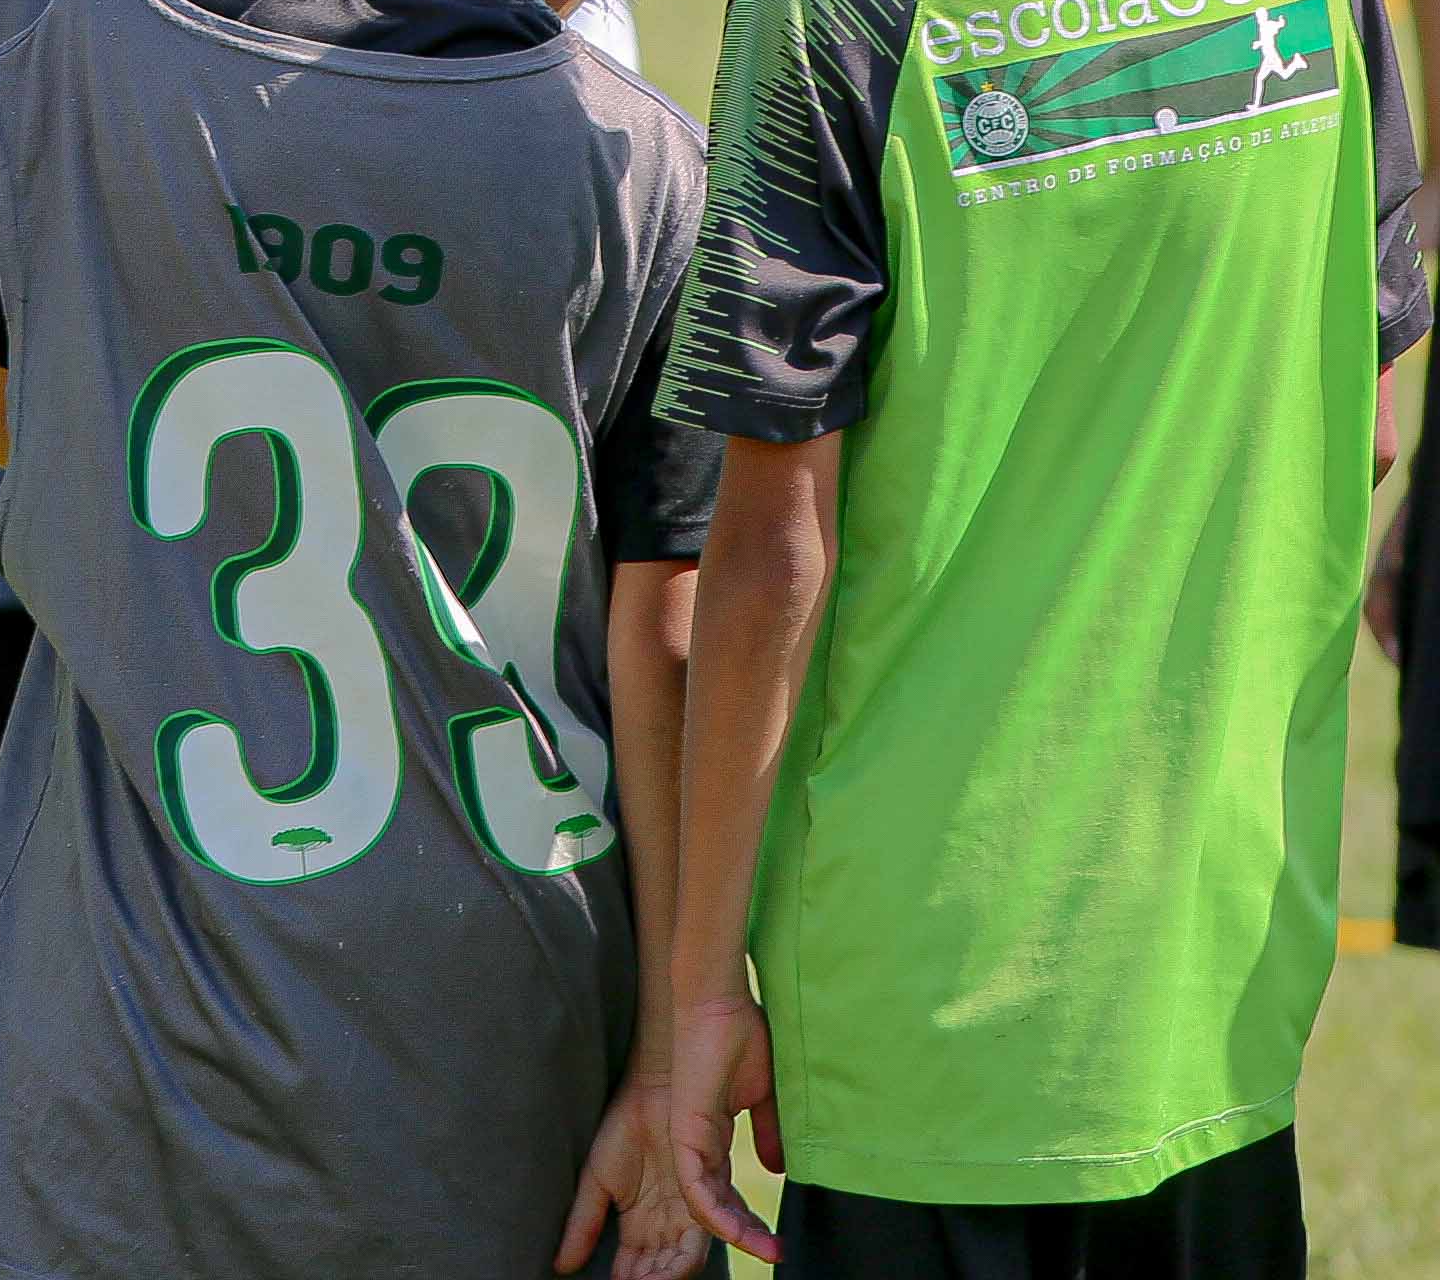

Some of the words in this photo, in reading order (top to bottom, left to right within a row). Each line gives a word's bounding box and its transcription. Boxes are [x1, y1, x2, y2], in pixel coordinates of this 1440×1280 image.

[956, 171, 1057, 208] CENTRO
[1067, 163, 1098, 185] DE
[1107, 136, 1242, 179] FORMAÇÃO
[1248, 127, 1274, 147] DE
[224, 203, 445, 306] 1909
